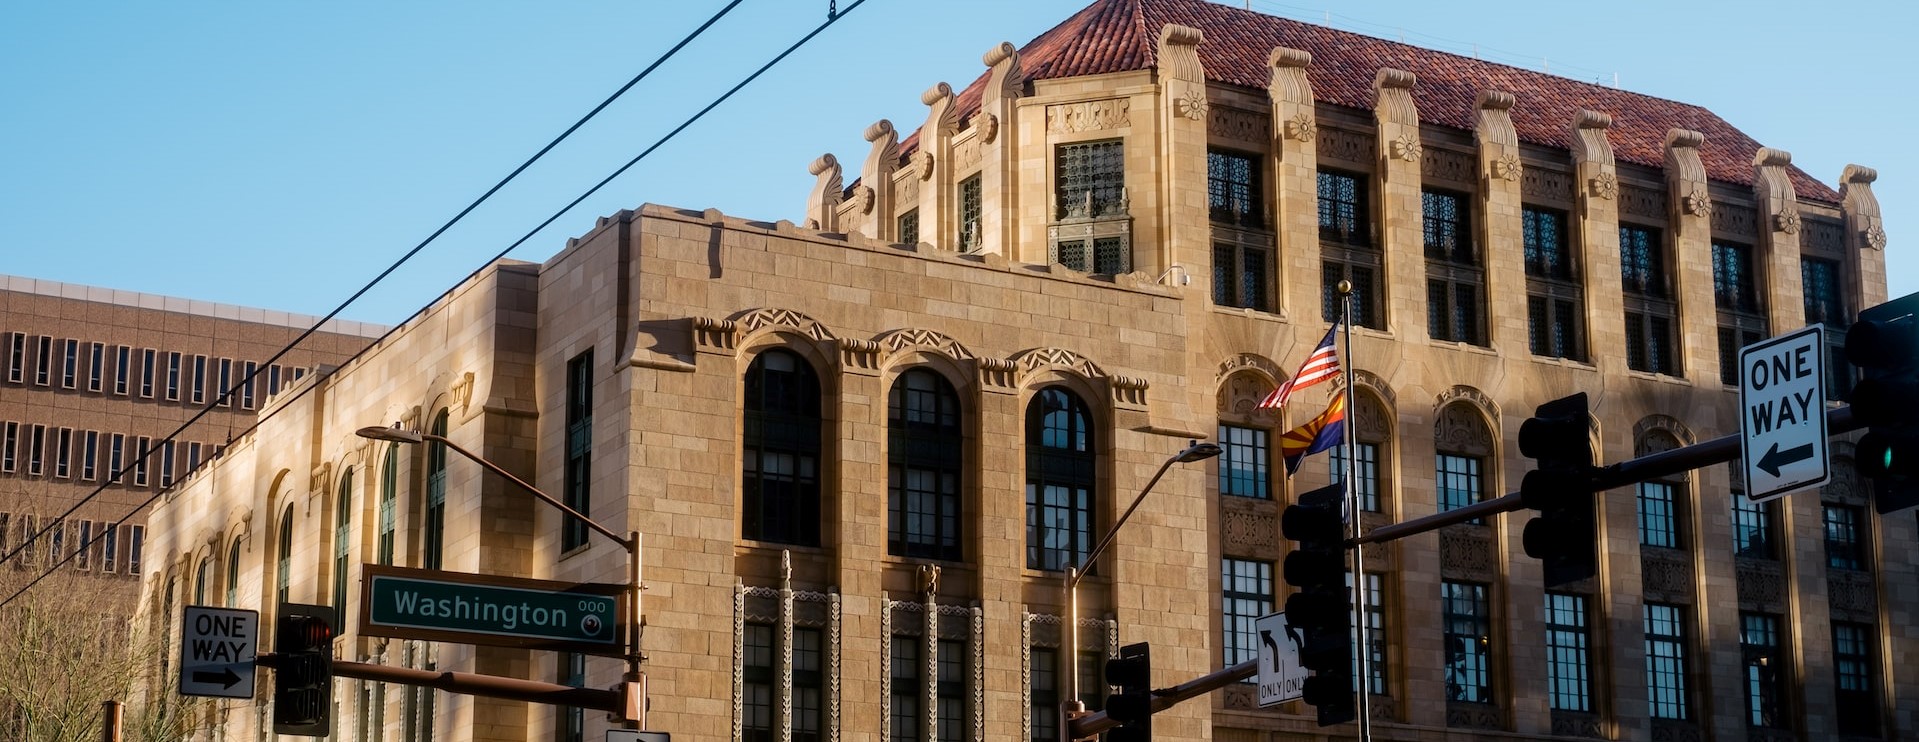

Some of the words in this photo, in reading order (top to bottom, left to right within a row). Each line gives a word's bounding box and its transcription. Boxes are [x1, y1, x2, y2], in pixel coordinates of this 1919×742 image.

[1751, 344, 1812, 391] ONE
[1751, 388, 1814, 436] WAY
[195, 614, 247, 638] ONE
[394, 590, 567, 630] Washington
[192, 639, 247, 662] WAY
[1262, 681, 1281, 699] ONLY
